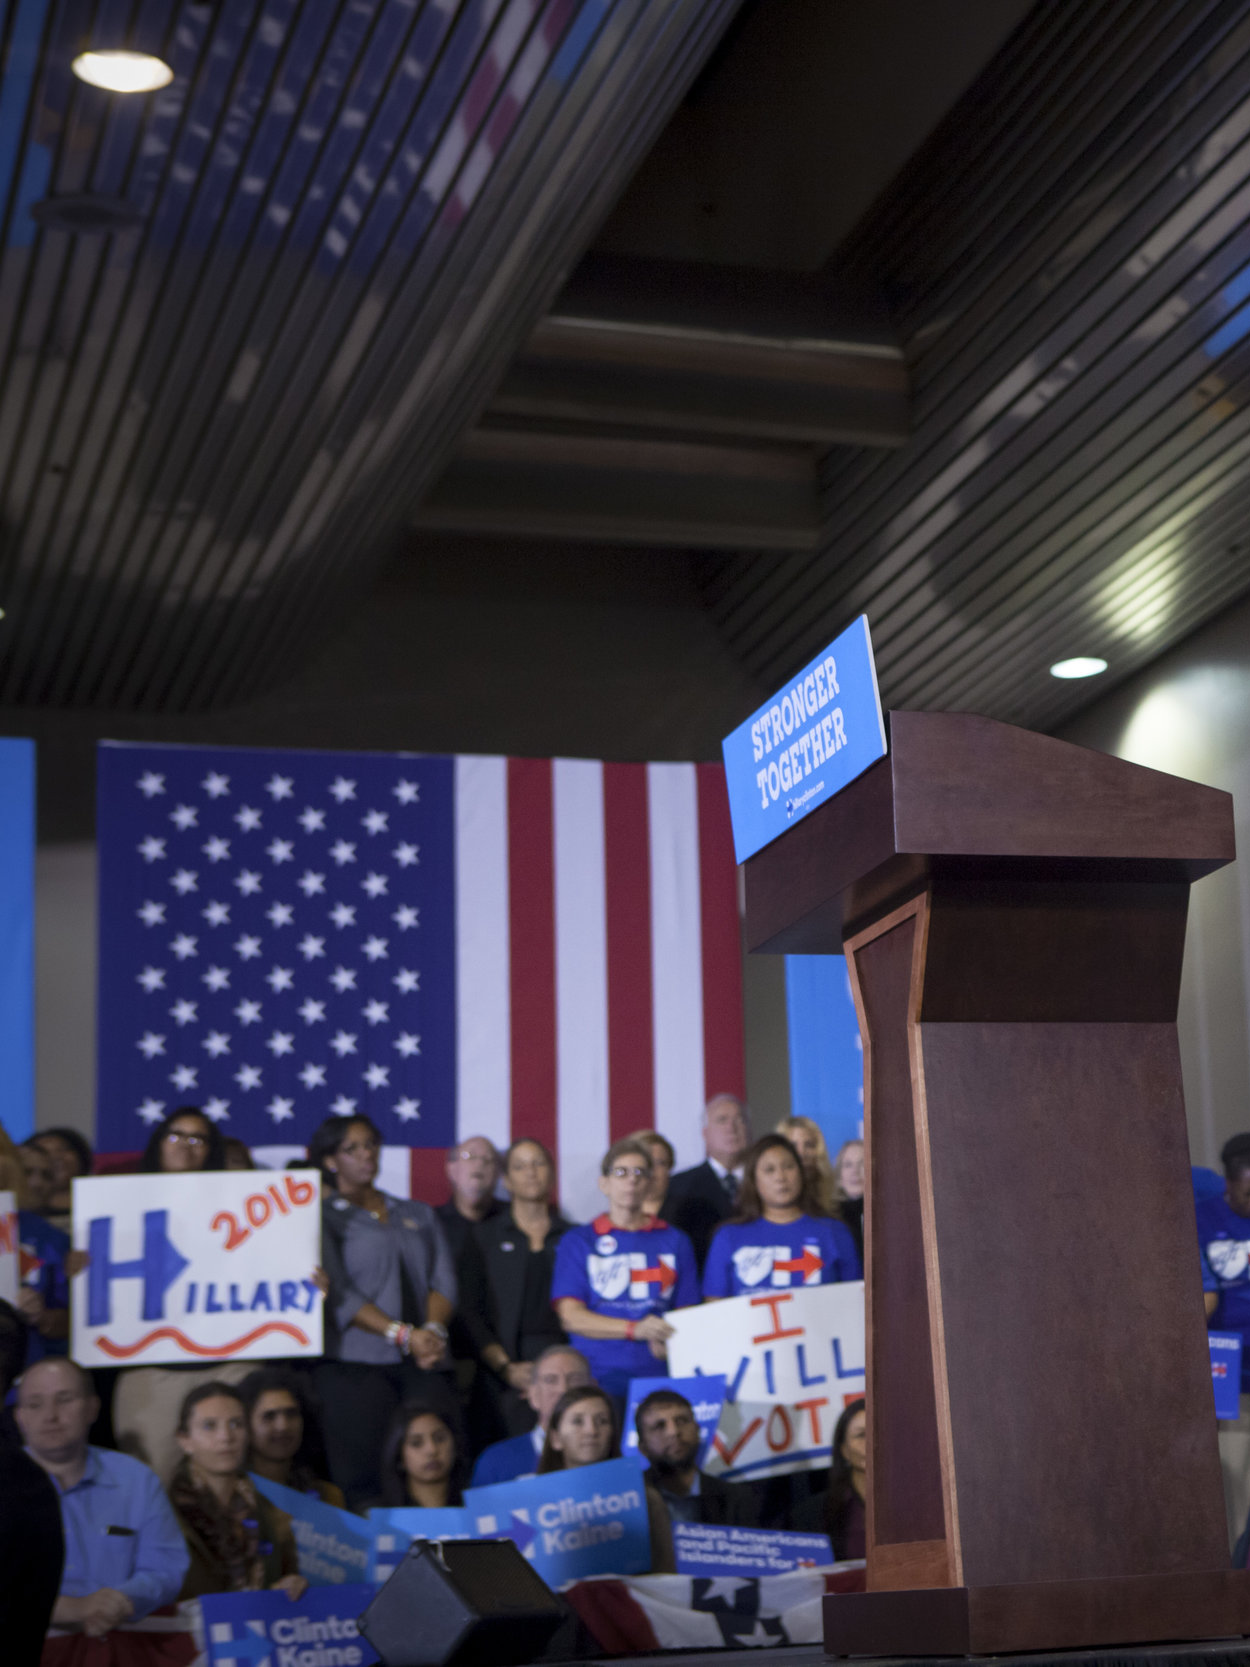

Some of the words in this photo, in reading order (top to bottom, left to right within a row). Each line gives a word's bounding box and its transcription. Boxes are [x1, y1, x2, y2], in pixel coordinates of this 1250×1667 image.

[752, 656, 840, 763] STRONGER
[757, 707, 847, 810] TOGETHER
[211, 1176, 316, 1250] 2016
[750, 1294, 805, 1345] I
[711, 1391, 866, 1467] VOT
[537, 1490, 641, 1528] Clinton
[289, 1519, 369, 1570] linton
[542, 1521, 625, 1555] Kaine
[676, 1524, 727, 1539] Asian
[731, 1529, 829, 1548] Americans
[678, 1538, 714, 1551] and
[718, 1540, 782, 1557] Pacific
[679, 1551, 766, 1568] Islanders
[768, 1557, 794, 1570] for
[271, 1615, 359, 1645] Clinto
[276, 1643, 363, 1667] Kaine
